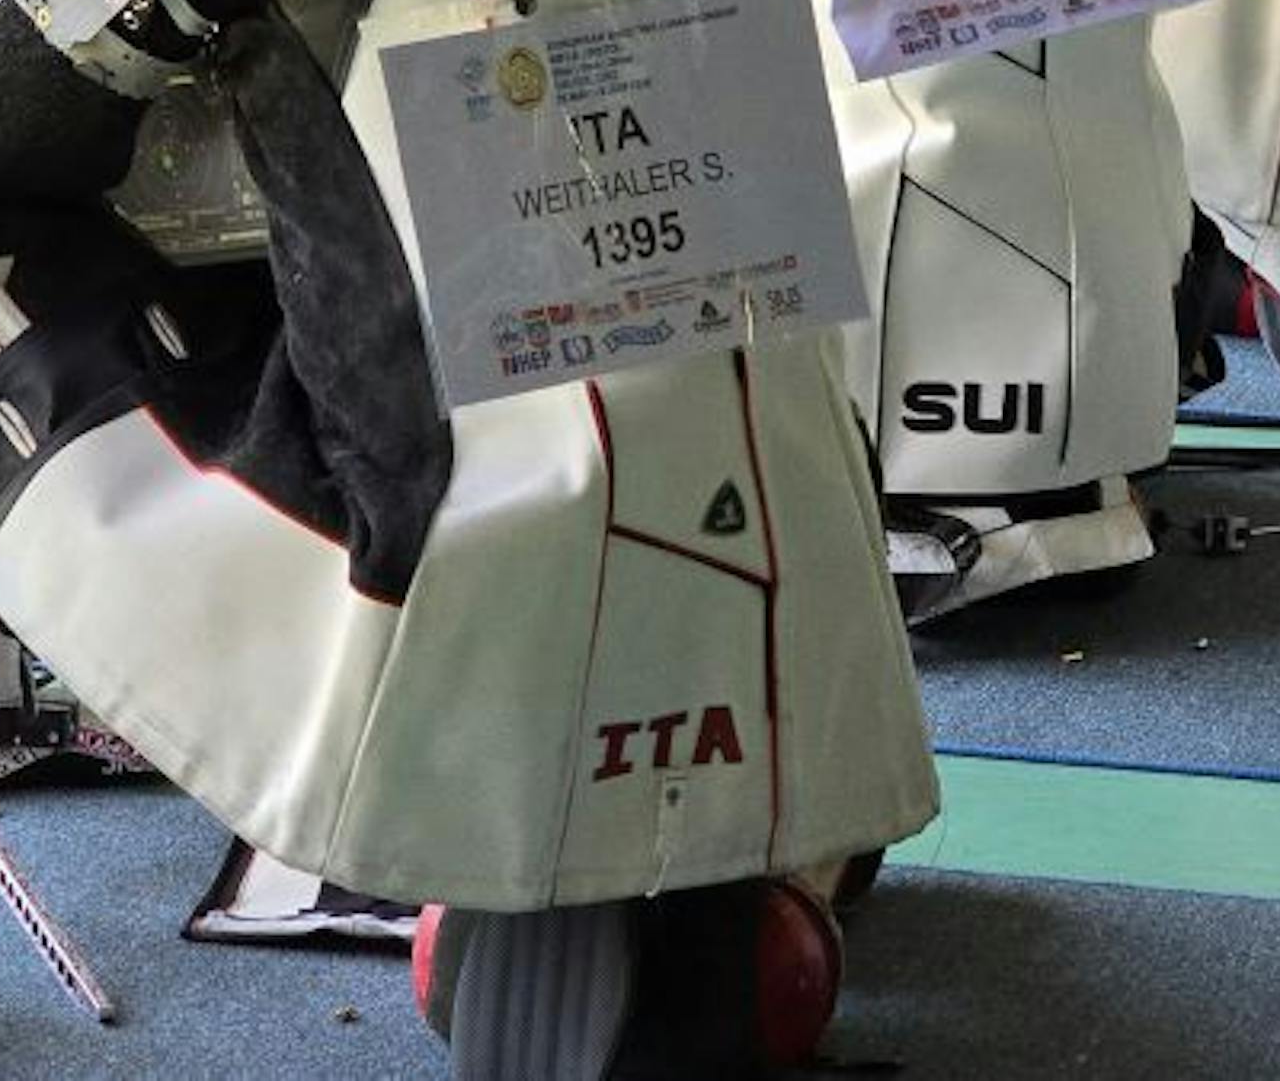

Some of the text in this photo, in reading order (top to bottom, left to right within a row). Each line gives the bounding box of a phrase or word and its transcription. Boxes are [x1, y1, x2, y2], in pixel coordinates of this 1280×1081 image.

[569, 105, 652, 156] ITA
[511, 151, 734, 219] WEITHALER S.
[581, 210, 687, 269] 1395
[901, 381, 1044, 435] SUI
[592, 705, 744, 783] ITA
